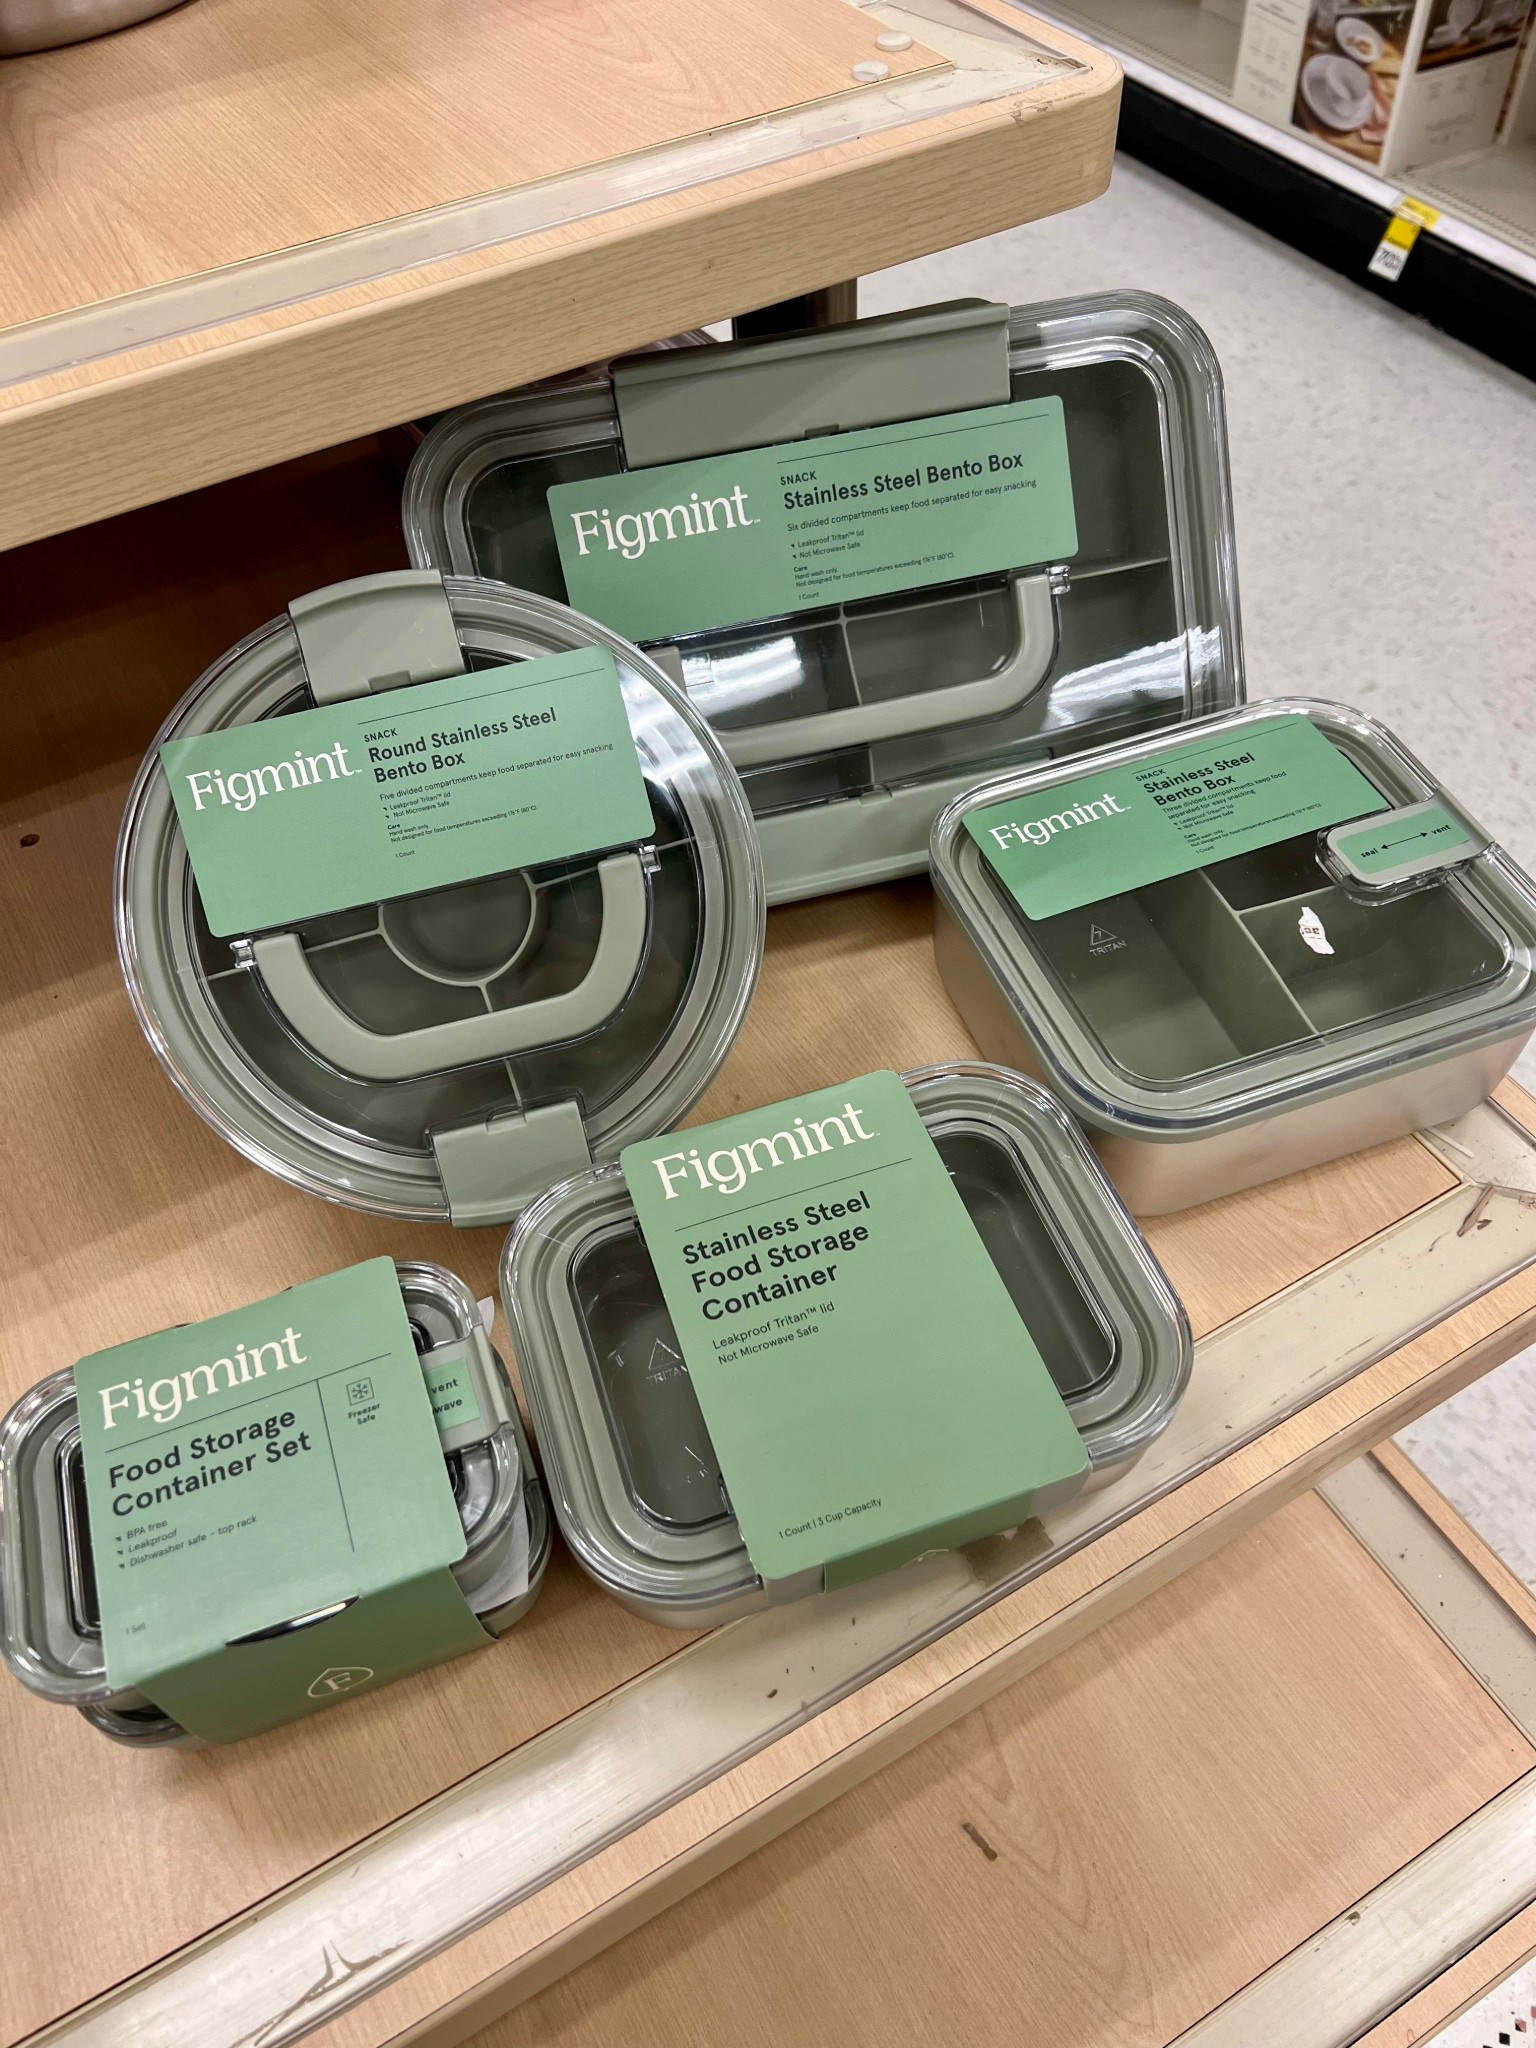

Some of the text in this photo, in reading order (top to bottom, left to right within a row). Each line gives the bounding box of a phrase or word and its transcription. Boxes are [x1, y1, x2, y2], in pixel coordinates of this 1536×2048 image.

[780, 470, 817, 486] SNACK
[784, 454, 1024, 510] Stainless Steel Bento Box
[787, 479, 1037, 532] Six divided compartments keep food separated for easy snacking
[797, 535, 830, 548] Leakproof
[855, 529, 865, 537] lid
[799, 541, 861, 559] Not Microwave Safe
[794, 572, 810, 580] Hand
[795, 580, 807, 588] Not
[807, 575, 833, 586] designed
[842, 571, 856, 579] food
[856, 565, 894, 576] temperatures
[894, 559, 922, 569] exceeding
[801, 591, 820, 600] Count
[363, 728, 398, 743] SNACK
[368, 706, 557, 763] Round Stainless Steel
[373, 752, 466, 783] Bento Box
[379, 743, 614, 801] Five divided compartments keep food separated for easy snacking
[1135, 768, 1166, 782] SNACK
[1143, 751, 1255, 793] Stainless Steel
[389, 798, 419, 811] Leakproof
[1152, 775, 1237, 806] Bento Box
[1161, 771, 1287, 814] Three divided compartments keep food
[1167, 805, 1201, 820] separated
[1211, 798, 1227, 806] easy
[1227, 789, 1256, 801] snacking
[393, 800, 450, 818] Not Microwave Safe
[1193, 814, 1222, 826] Microwave
[388, 829, 403, 837] Hand
[401, 831, 425, 841] designed
[433, 825, 447, 834] food
[446, 819, 481, 831] temperatures
[481, 812, 508, 823] exceeding
[1360, 824, 1451, 858] seal vent
[398, 849, 416, 858] Count
[1089, 940, 1128, 957] TRITAN
[682, 1190, 871, 1265] Stainless Steel
[691, 1226, 869, 1294] Food Storage
[702, 1264, 837, 1321] Container
[712, 1300, 835, 1350] Leakproof Tritan™ lid
[718, 1325, 819, 1365] Not Microwave Safe
[431, 1378, 458, 1394] vent
[348, 1403, 380, 1419] Freezer
[357, 1414, 376, 1425] Safe
[109, 1411, 296, 1489] Food Storage
[112, 1431, 312, 1517] Container Set
[126, 1520, 168, 1540] BPA free
[784, 1521, 812, 1537] Count
[817, 1516, 824, 1526] 3
[824, 1512, 844, 1523] Cup
[844, 1498, 882, 1516] Capacity
[128, 1528, 177, 1553] Leakproof
[129, 1541, 185, 1567] Dishwasher
[187, 1534, 207, 1546] safe
[217, 1524, 235, 1535] top
[236, 1515, 257, 1528] rack
[323, 1672, 350, 1691] F
